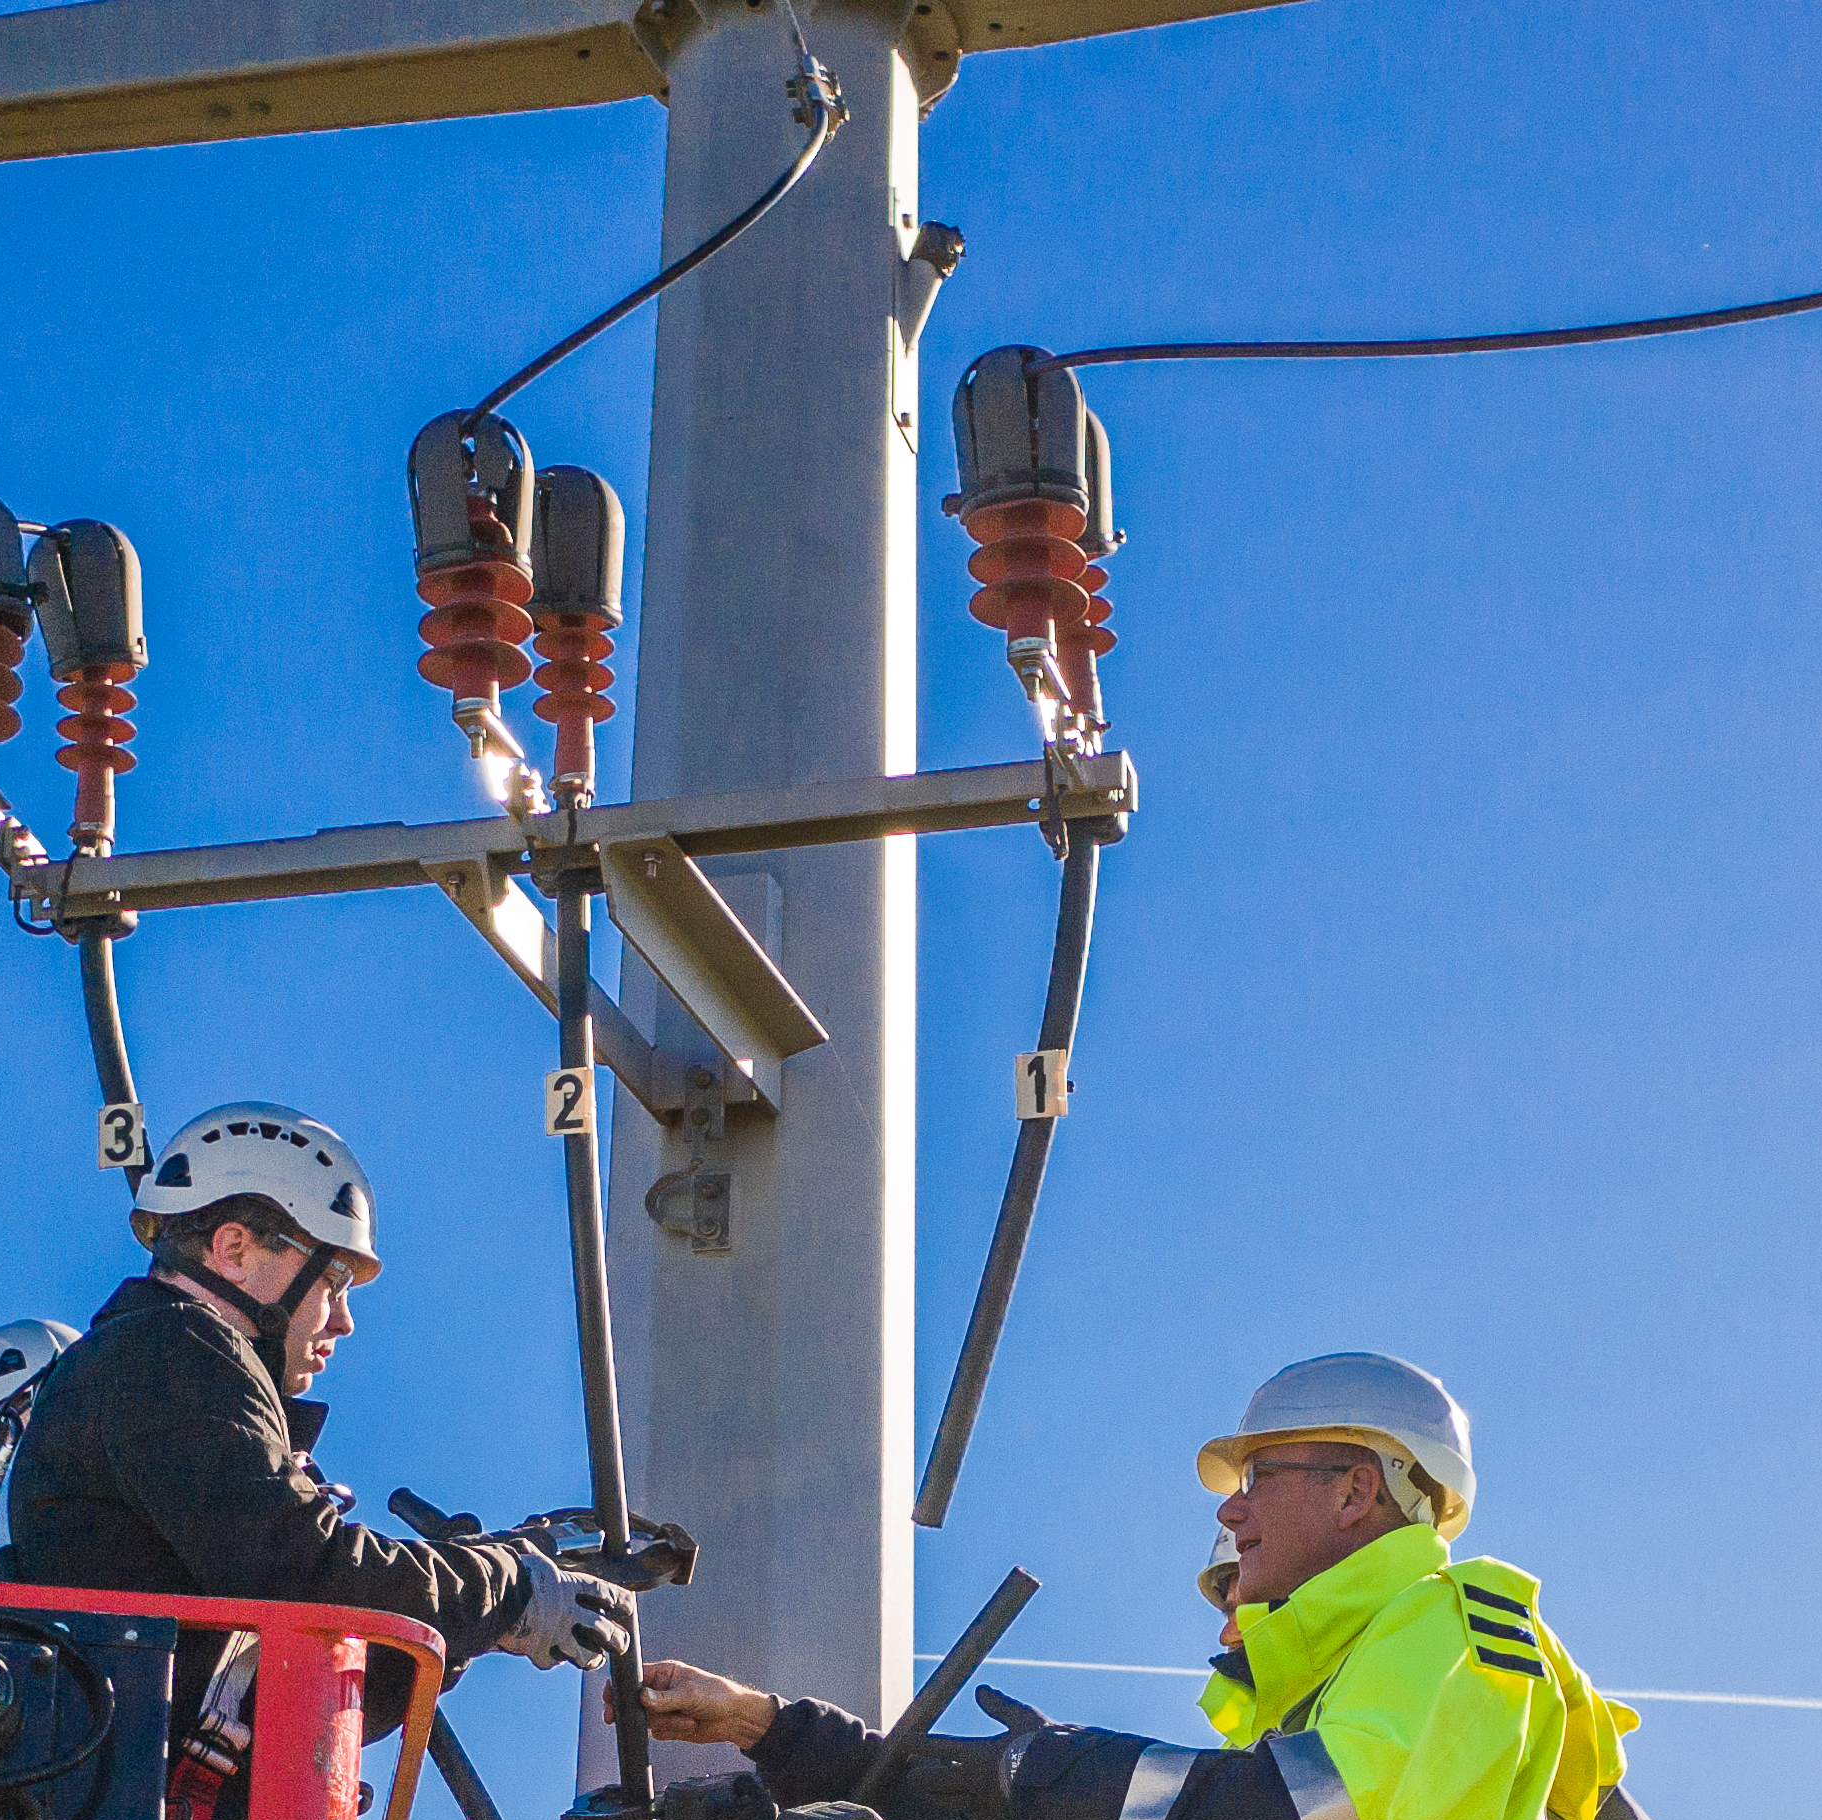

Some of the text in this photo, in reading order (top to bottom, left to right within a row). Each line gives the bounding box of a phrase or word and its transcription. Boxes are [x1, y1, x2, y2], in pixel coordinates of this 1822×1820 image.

[553, 1073, 584, 1130] 2
[1027, 1055, 1047, 1114] 1
[104, 1108, 135, 1163] 3
